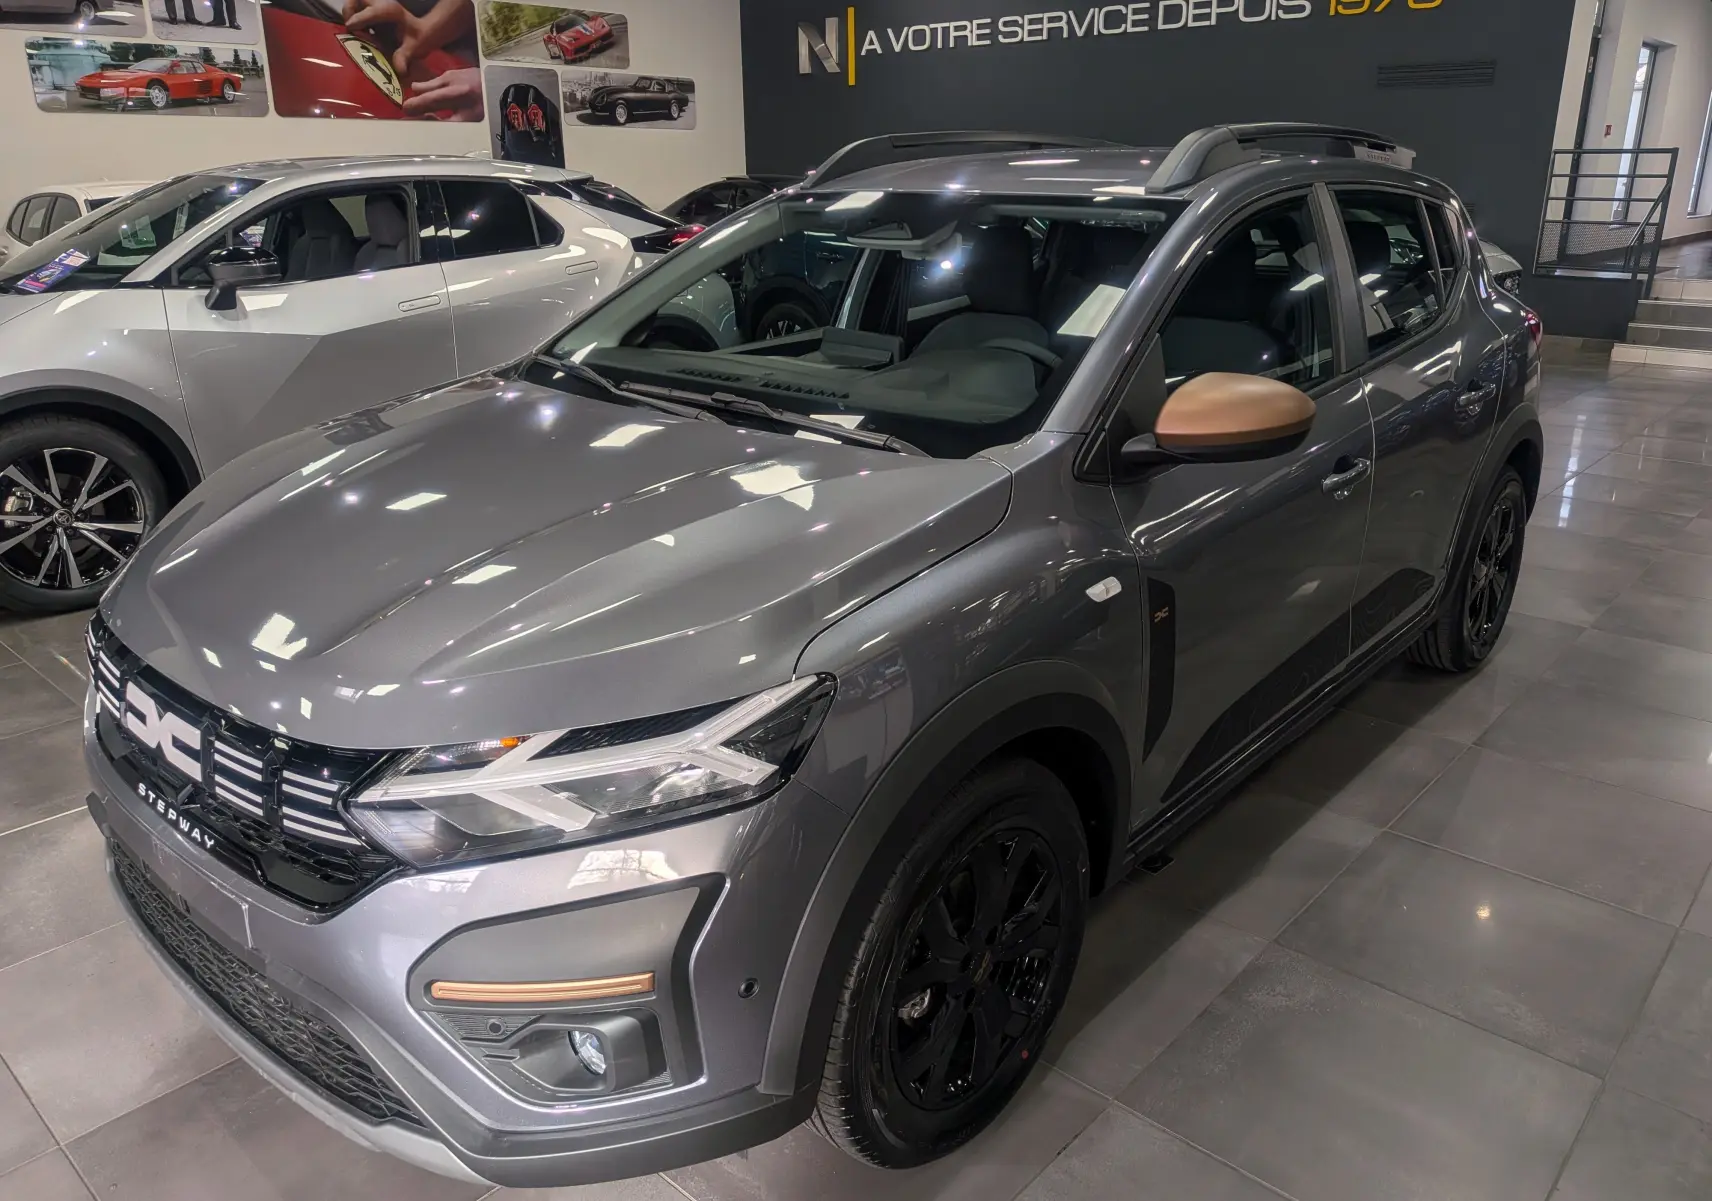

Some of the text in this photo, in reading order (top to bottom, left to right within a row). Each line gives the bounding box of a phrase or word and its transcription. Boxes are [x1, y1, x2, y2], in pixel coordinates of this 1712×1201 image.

[860, 30, 883, 55] A
[887, 18, 992, 53] VOTRE
[998, 2, 1150, 44] SERVICE
[1157, 0, 1312, 30] DEPUIS
[137, 782, 215, 849] STEPWAY
